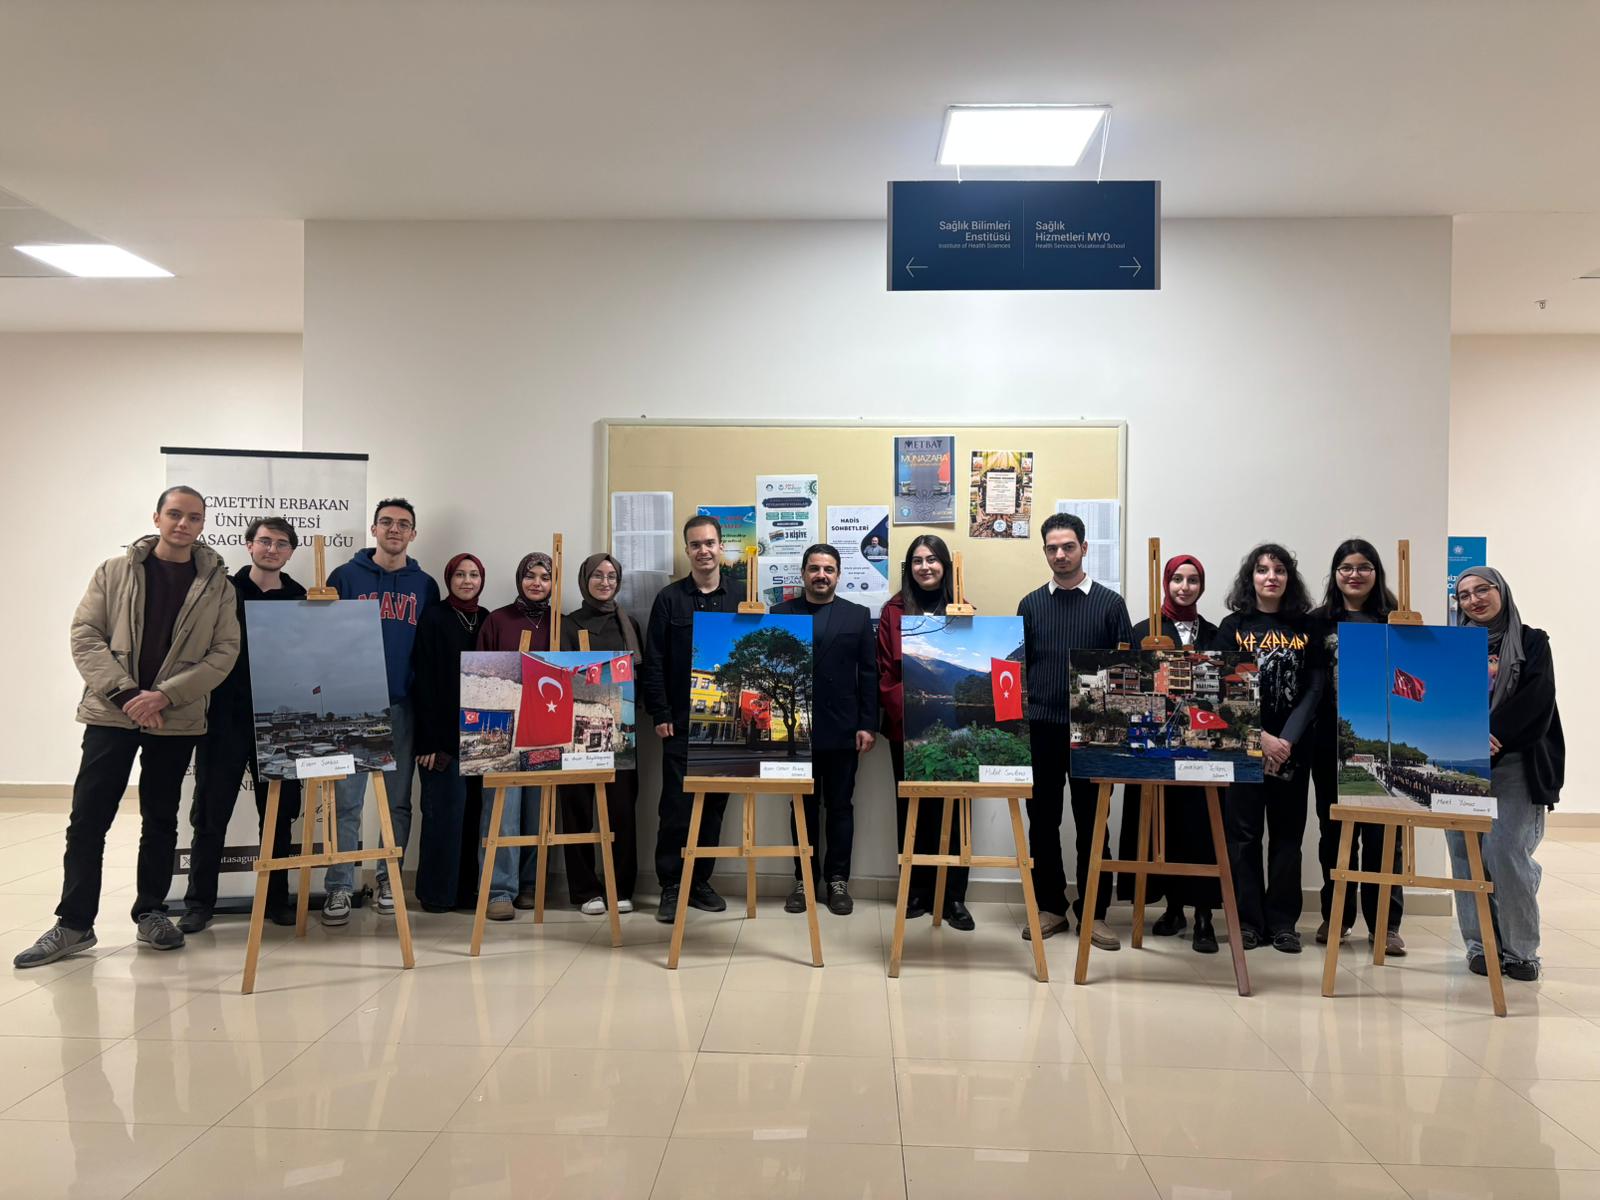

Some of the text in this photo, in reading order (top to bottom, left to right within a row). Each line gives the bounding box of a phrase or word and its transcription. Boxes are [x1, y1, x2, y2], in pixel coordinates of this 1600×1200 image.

[939, 221, 1011, 232] Sağlık Bilimleri
[1035, 221, 1065, 232] Sağlık
[965, 232, 1011, 242] Enstitüsü
[1035, 232, 1111, 242] Hizmetleri MYO
[204, 494, 350, 511] CMETTİN ERBAKAN
[215, 512, 321, 529] ÜNİVTESİ
[790, 530, 807, 540] KİŞİYE
[199, 534, 354, 548] ASAGU LUUĞU
